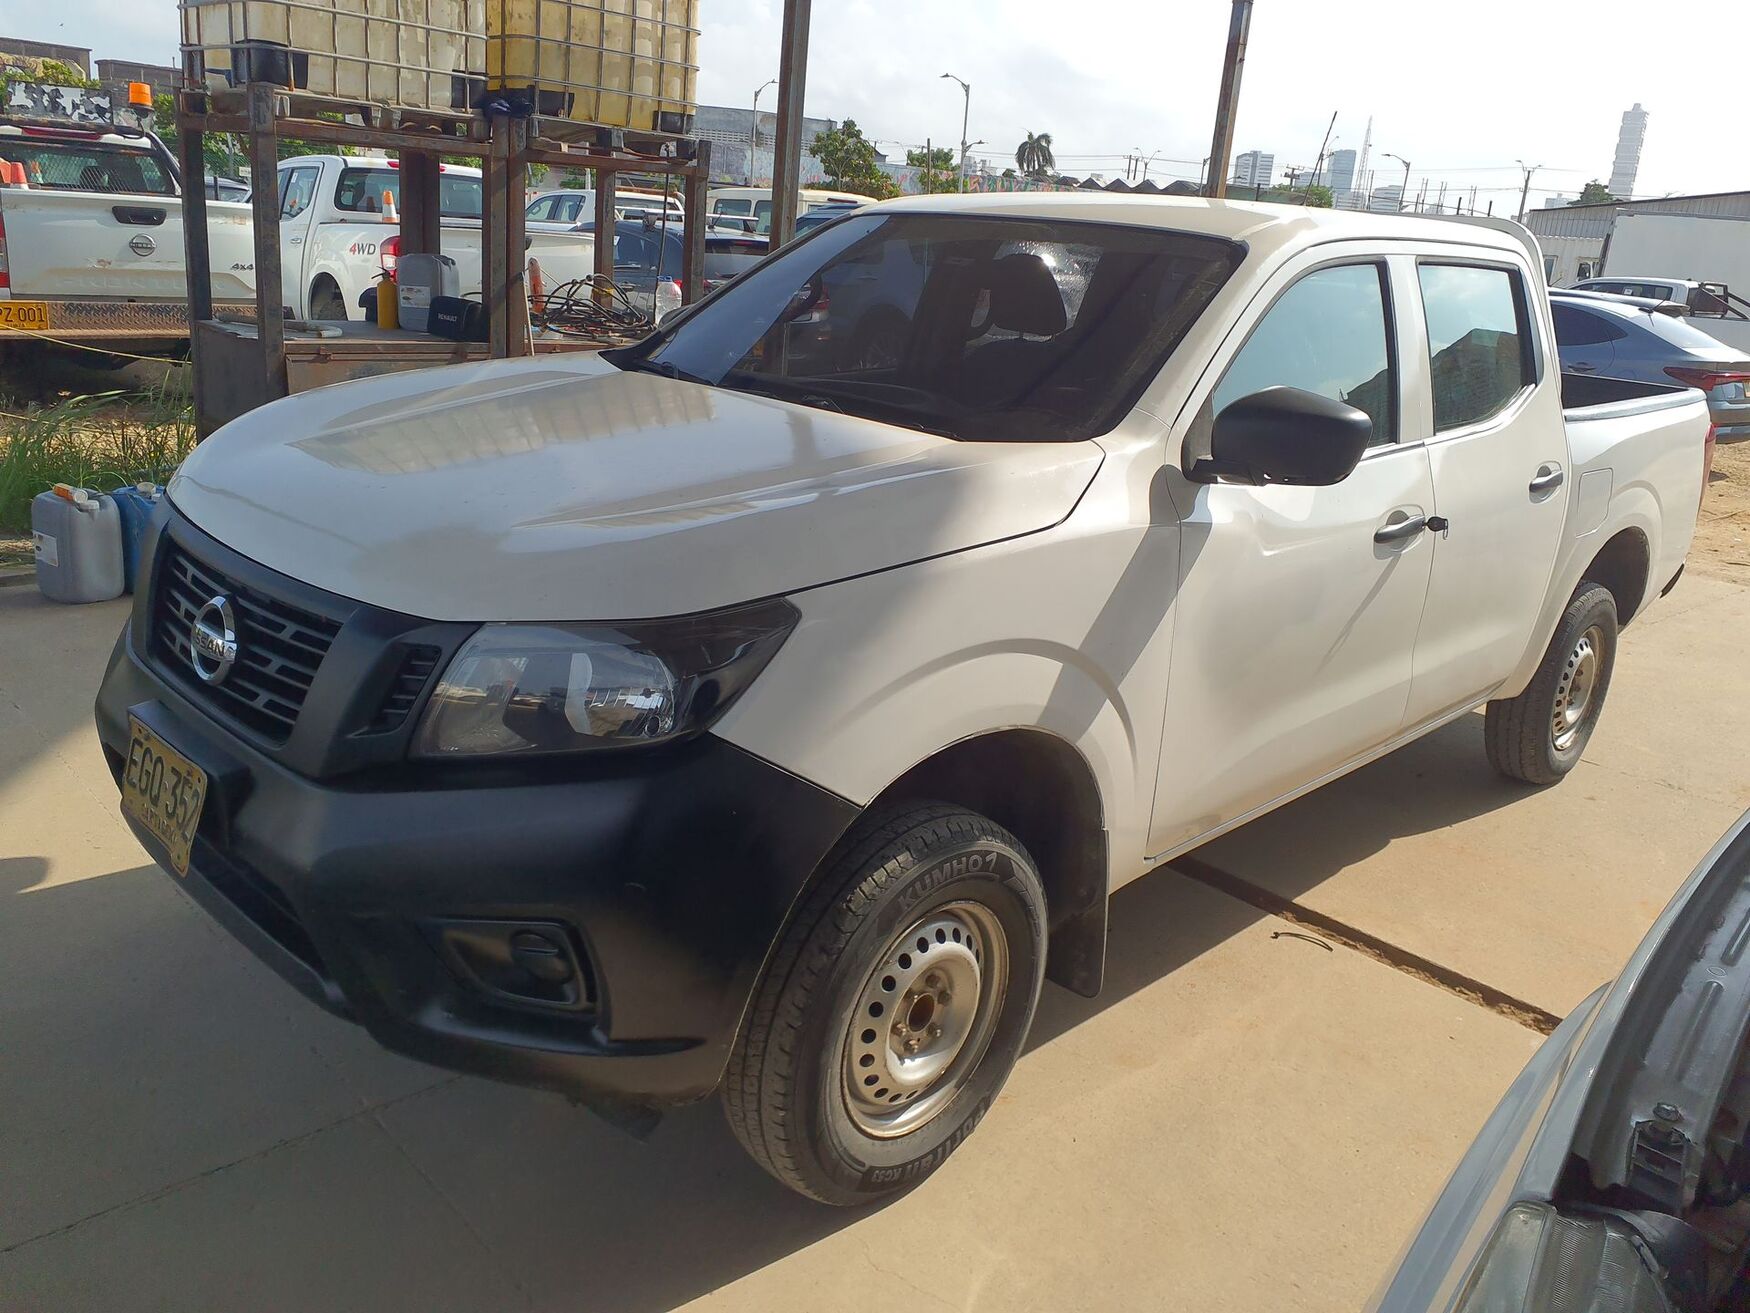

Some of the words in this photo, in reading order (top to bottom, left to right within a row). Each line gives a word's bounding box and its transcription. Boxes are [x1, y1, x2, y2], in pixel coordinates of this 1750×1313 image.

[350, 242, 376, 255] 4WD
[18, 307, 45, 322] 001
[165, 766, 201, 843] 352
[899, 854, 983, 910] KUMHO
